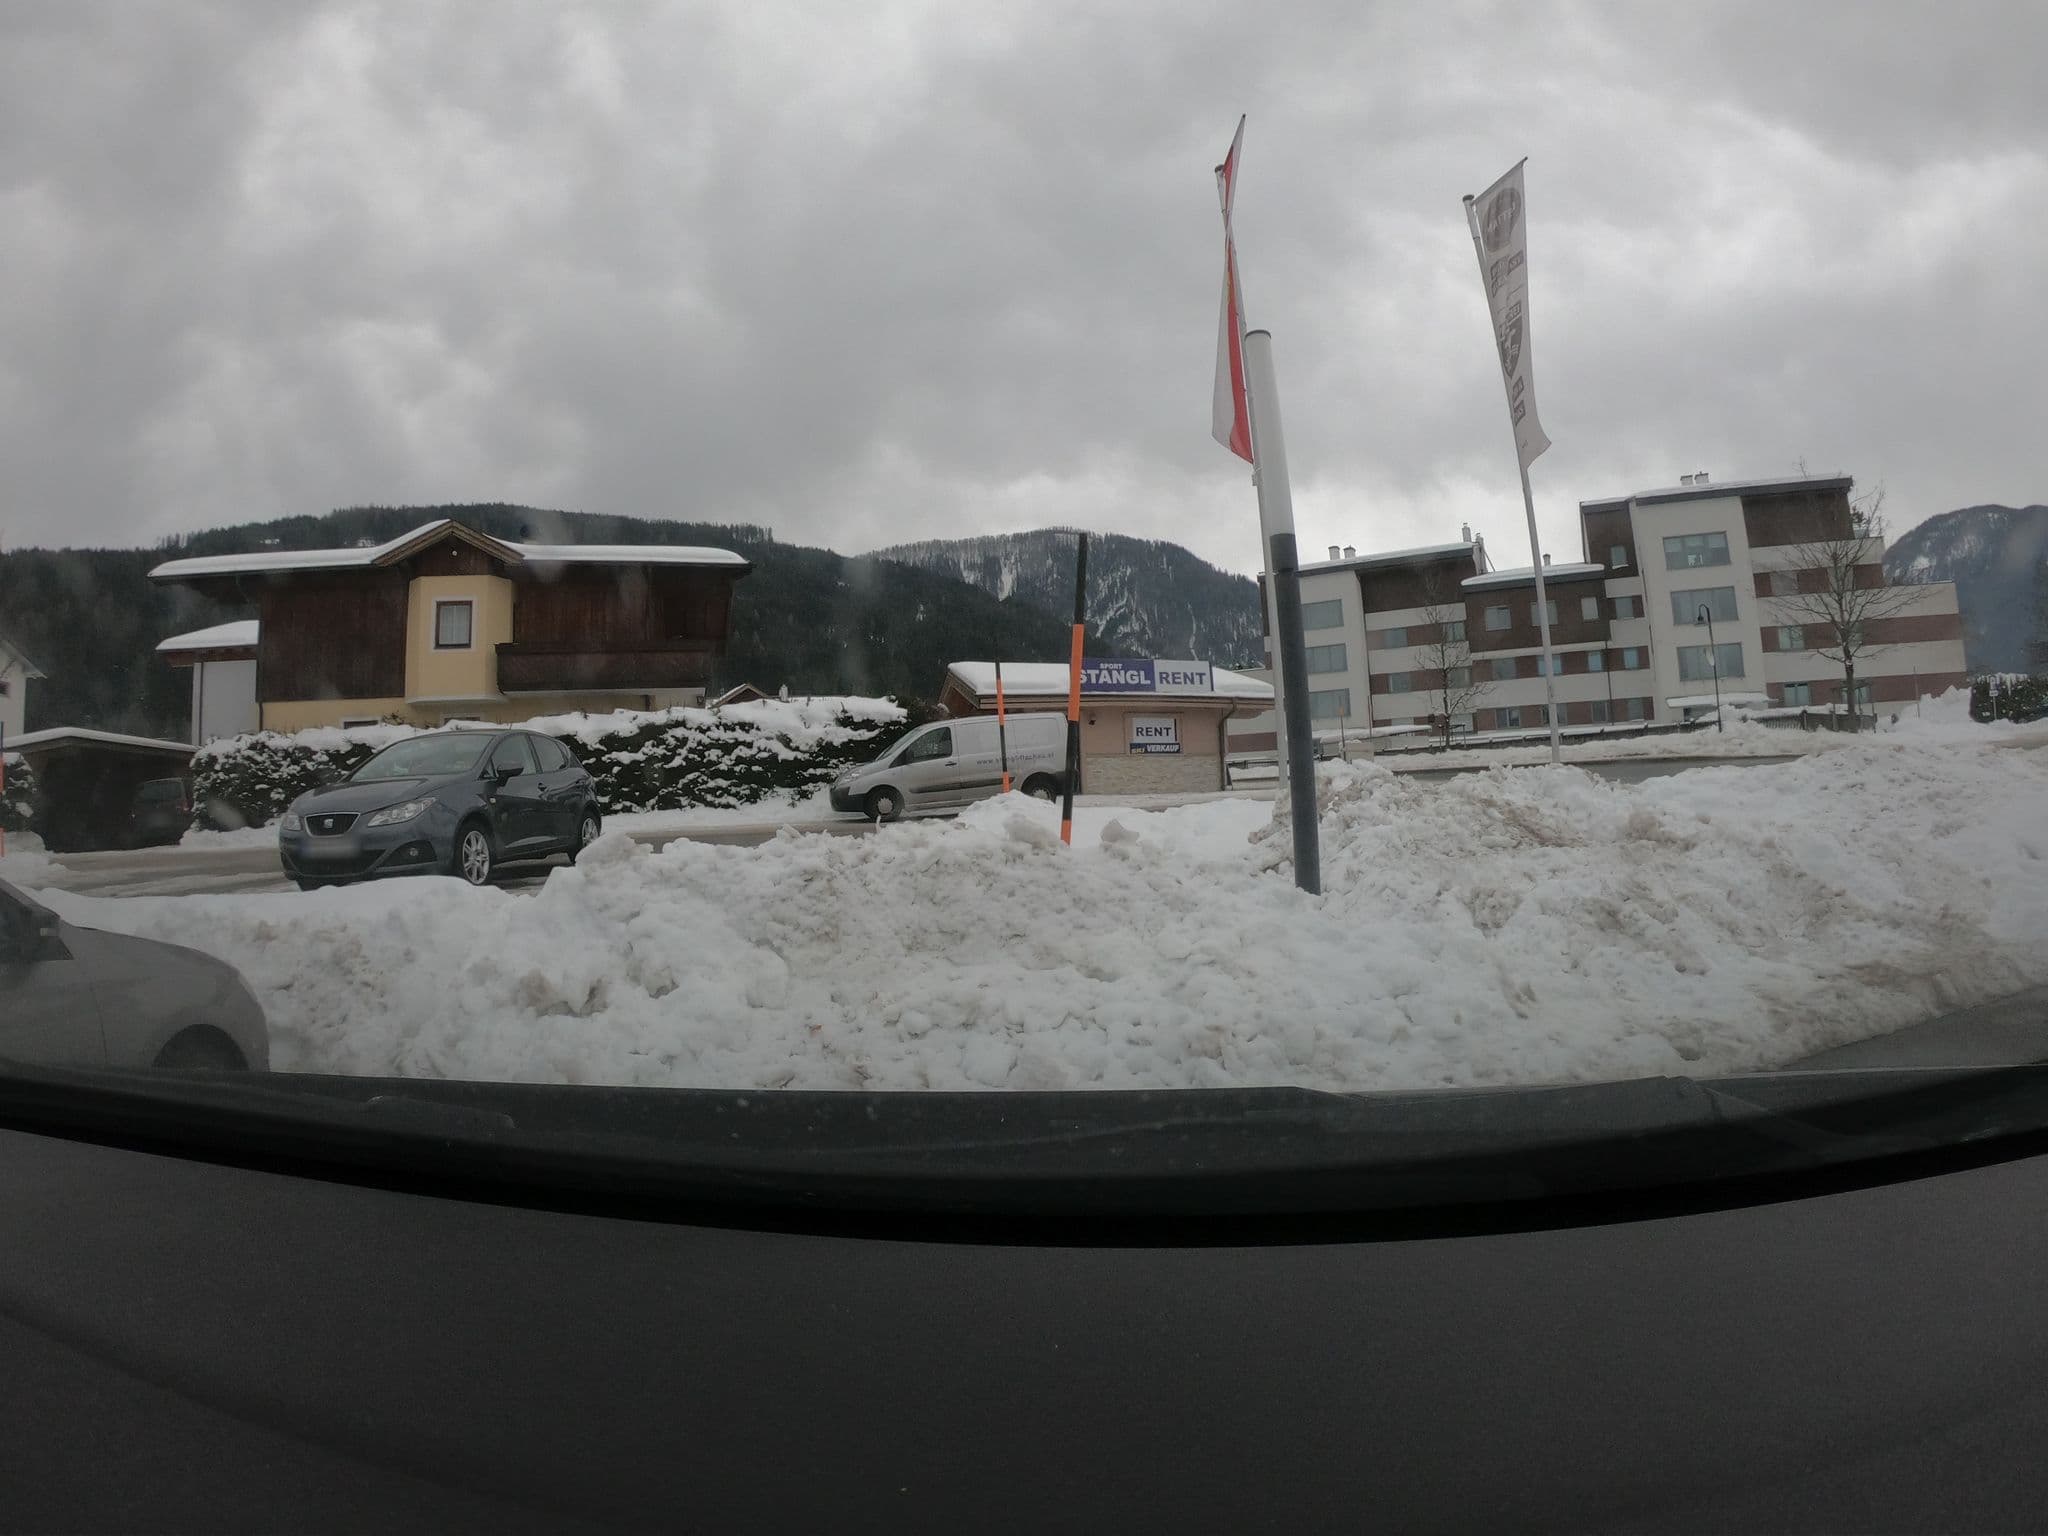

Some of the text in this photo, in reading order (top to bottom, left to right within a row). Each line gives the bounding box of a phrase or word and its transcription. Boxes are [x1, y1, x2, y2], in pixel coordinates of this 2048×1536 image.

[1080, 670, 1206, 685] STANGL RENT
[1136, 727, 1172, 737] RENT
[1146, 744, 1180, 753] VERKAUF
